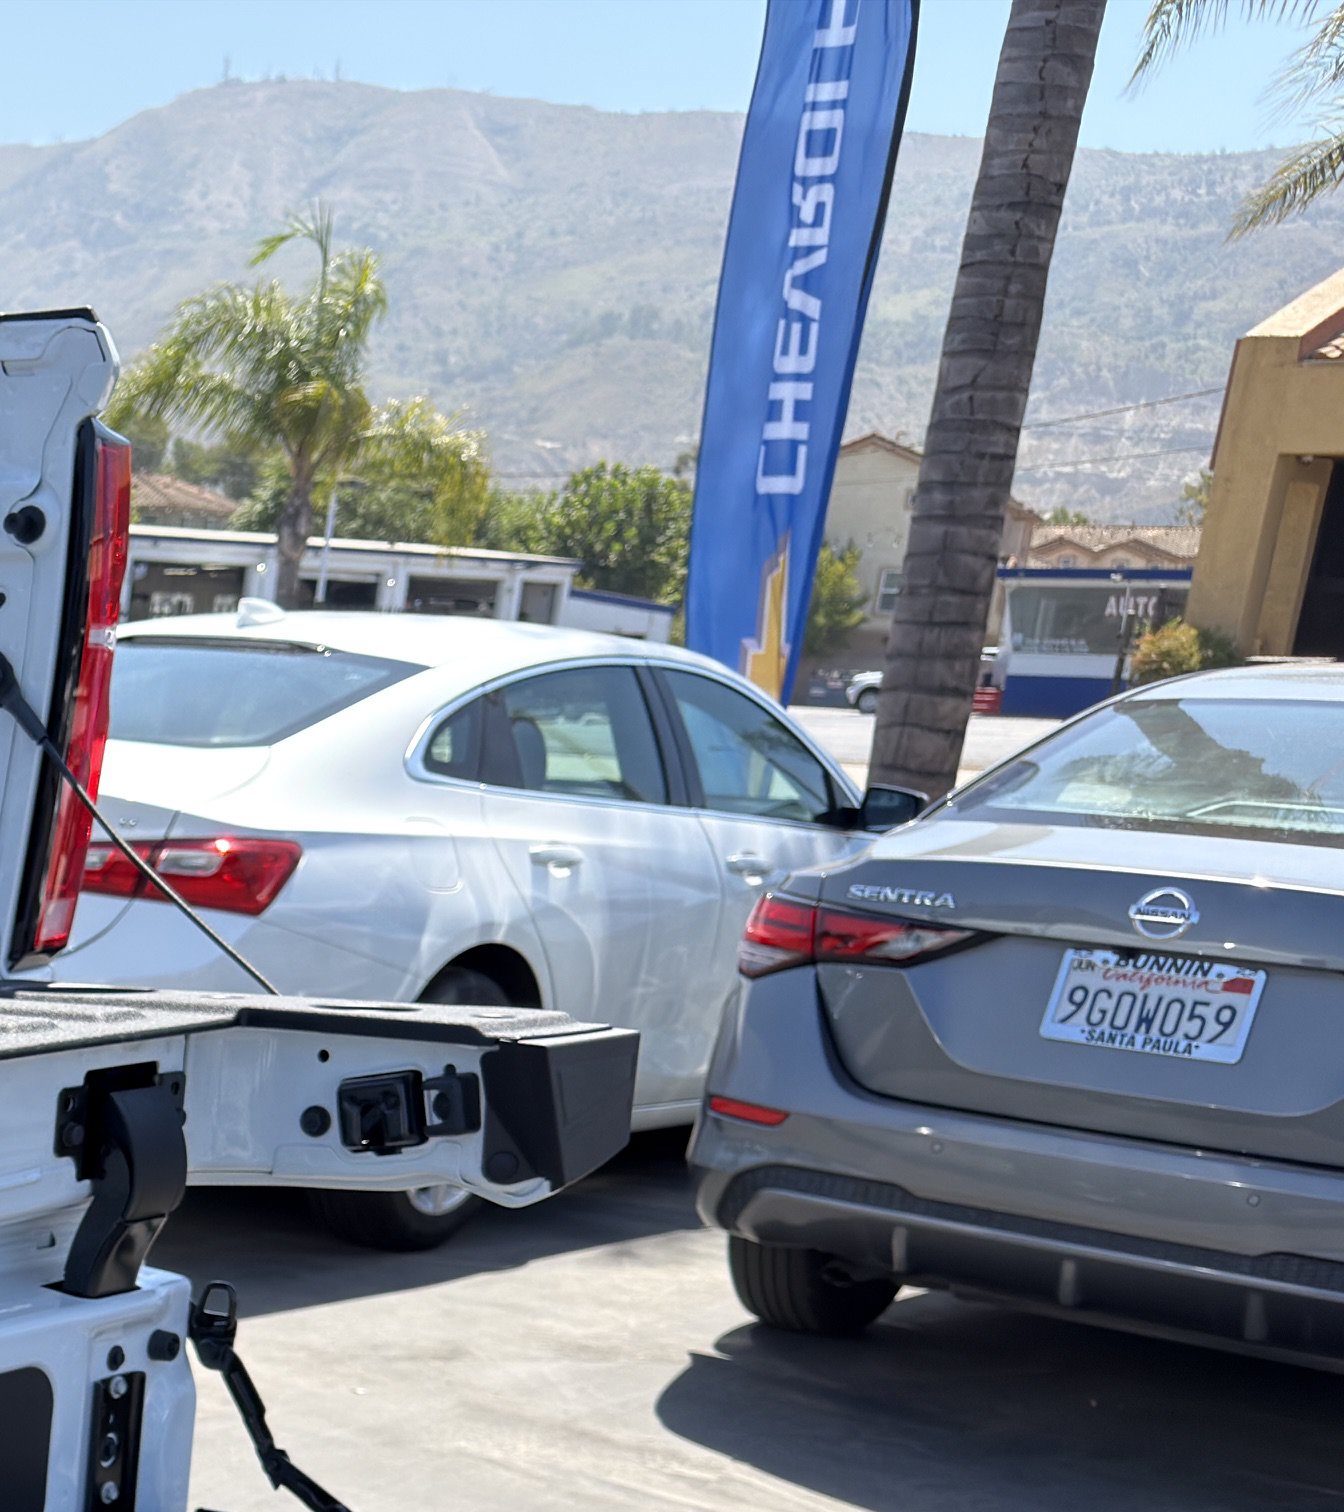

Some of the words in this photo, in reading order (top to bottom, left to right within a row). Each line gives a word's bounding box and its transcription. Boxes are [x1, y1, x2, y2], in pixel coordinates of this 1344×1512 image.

[848, 884, 956, 909] SENTRA
[1134, 906, 1192, 921] NISSAN
[1102, 968, 1211, 991] California
[1084, 1027, 1136, 1048] SANTA
[1141, 1037, 1194, 1056] PAULA
